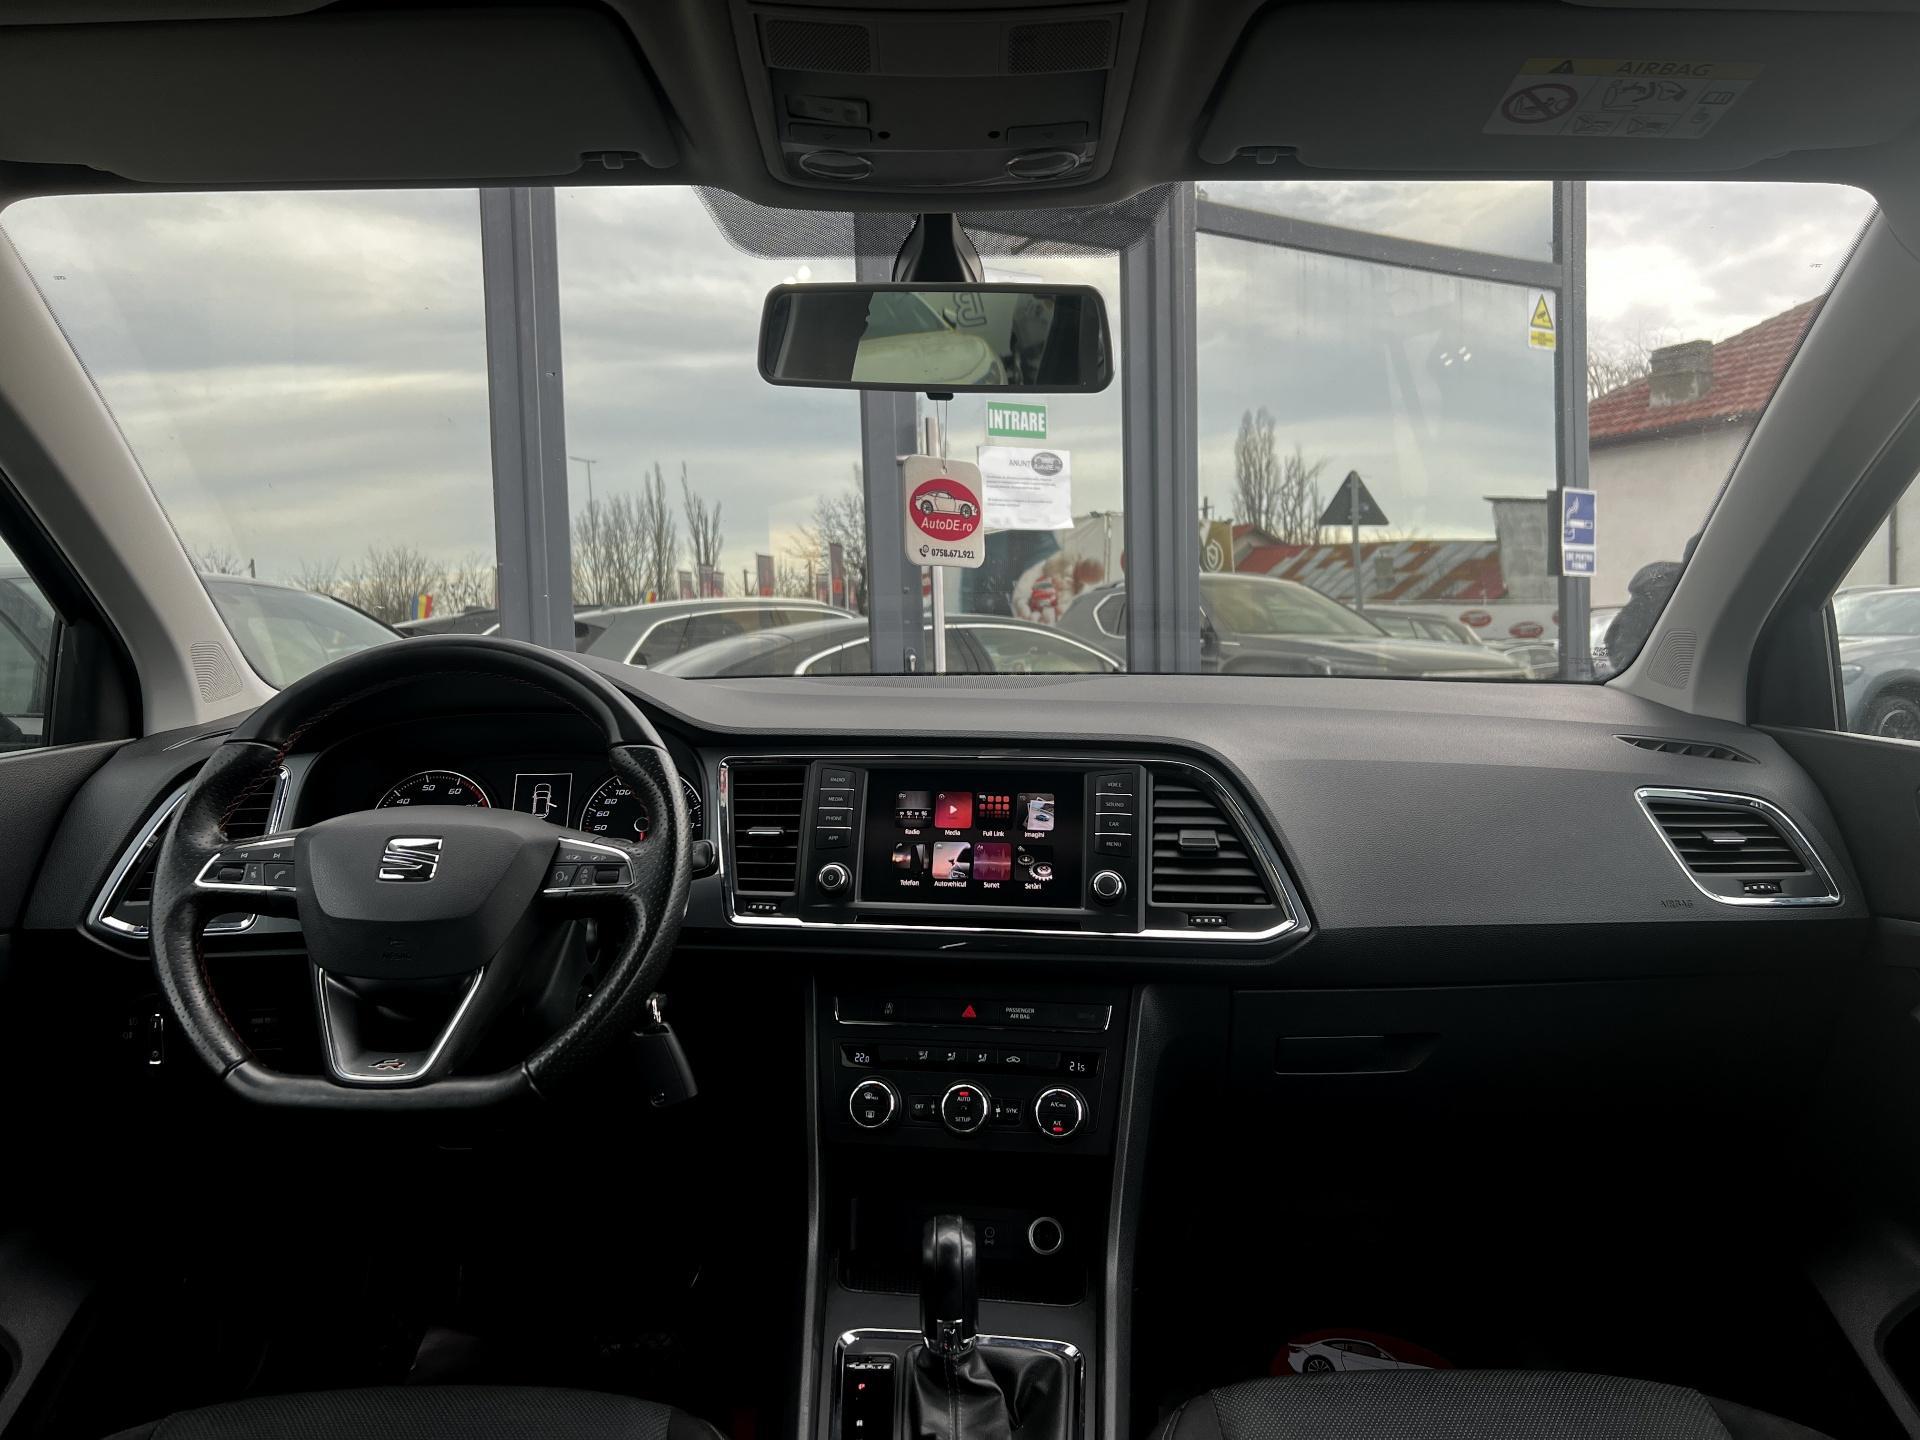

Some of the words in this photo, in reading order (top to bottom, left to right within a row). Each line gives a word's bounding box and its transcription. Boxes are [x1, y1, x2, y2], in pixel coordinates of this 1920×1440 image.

[1616, 61, 1712, 76] AIRBAG
[989, 408, 1045, 432] INTRARE
[921, 517, 973, 532] AutoDE.ro
[931, 548, 975, 559] 0758.671.921
[934, 880, 966, 888] Autovehicul
